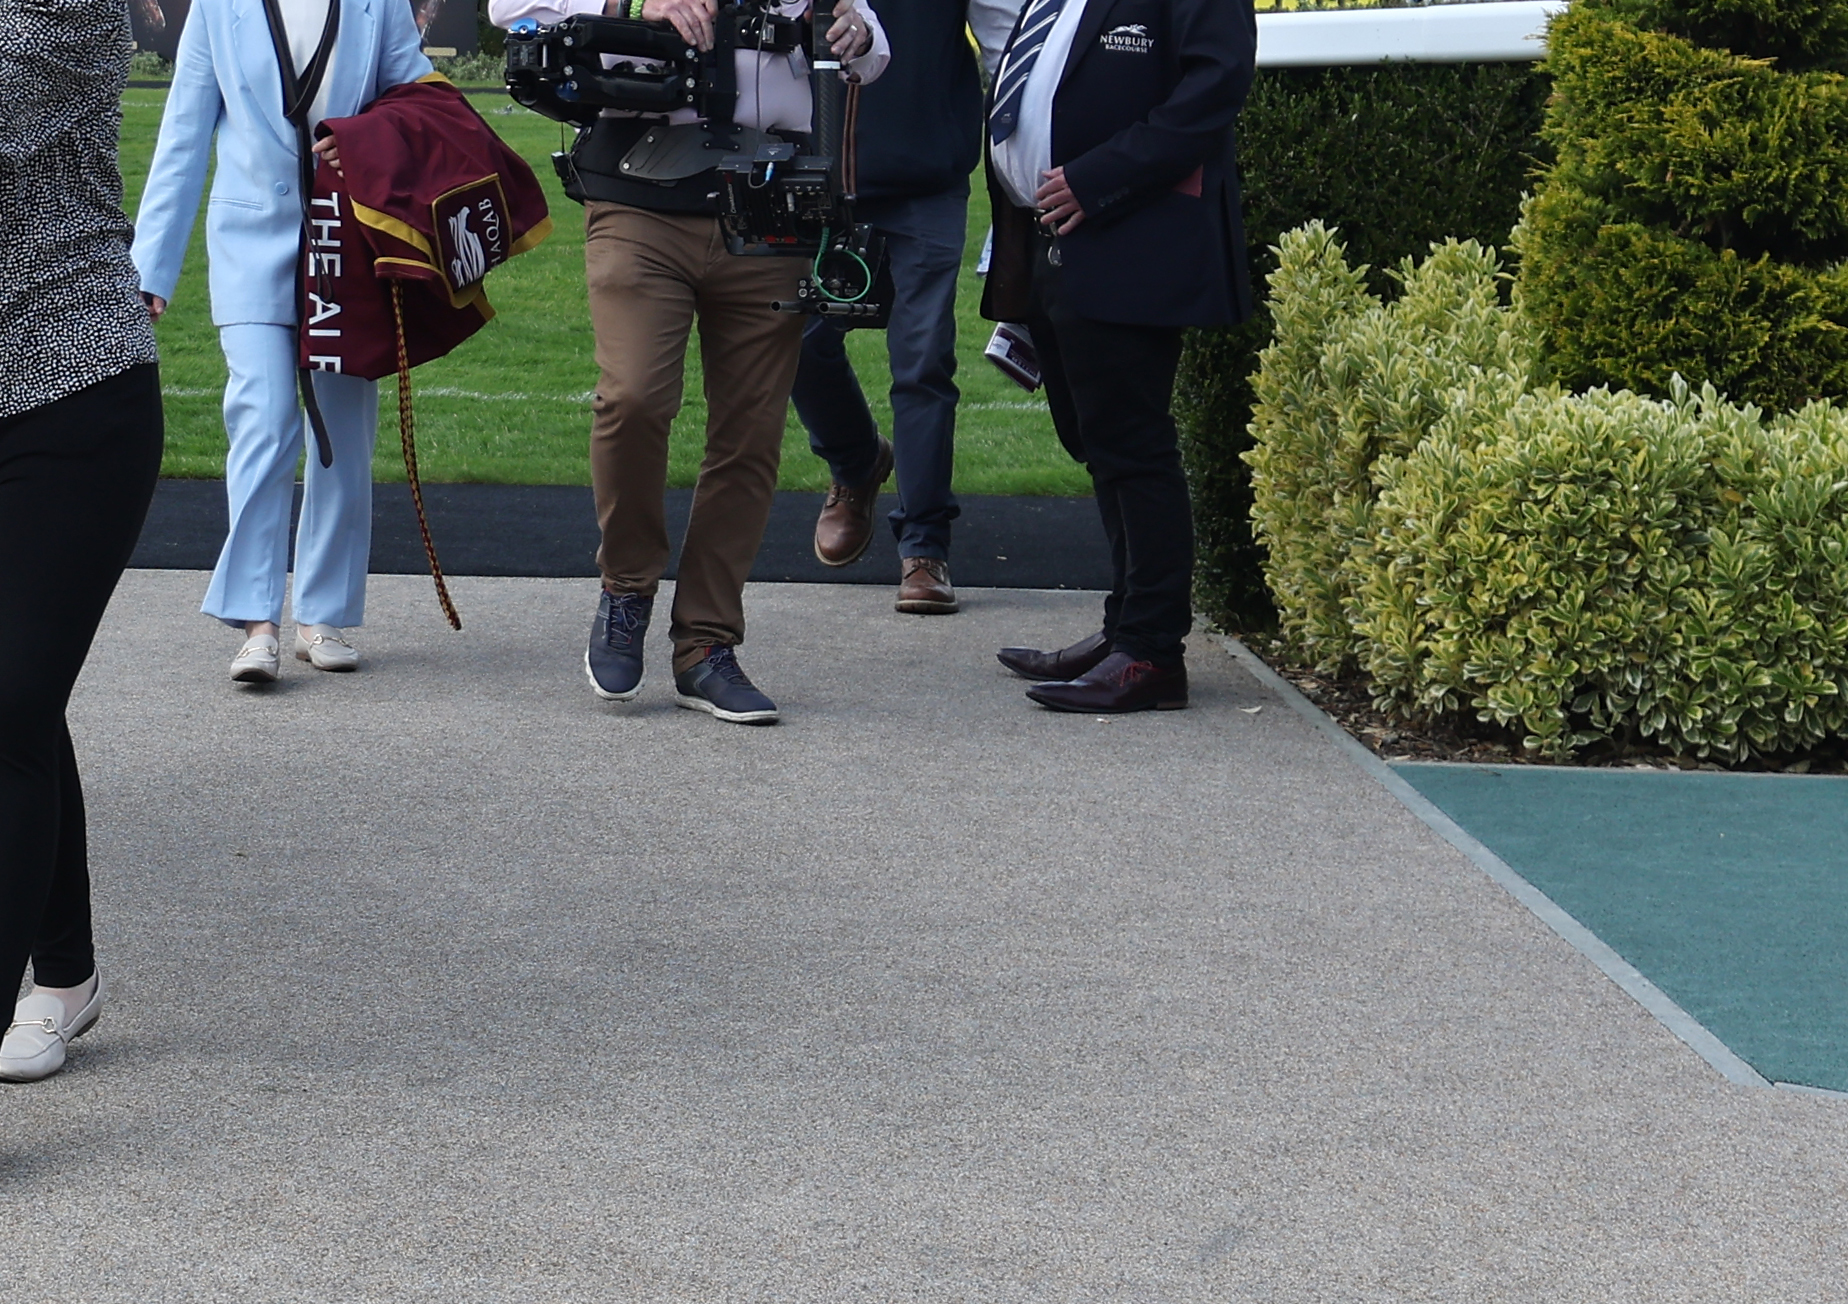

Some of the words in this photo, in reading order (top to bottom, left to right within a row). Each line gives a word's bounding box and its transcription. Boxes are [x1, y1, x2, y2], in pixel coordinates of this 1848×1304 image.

[1099, 34, 1155, 48] NEWBURY
[1104, 43, 1148, 54] RACECOURSE
[308, 192, 342, 277] THE
